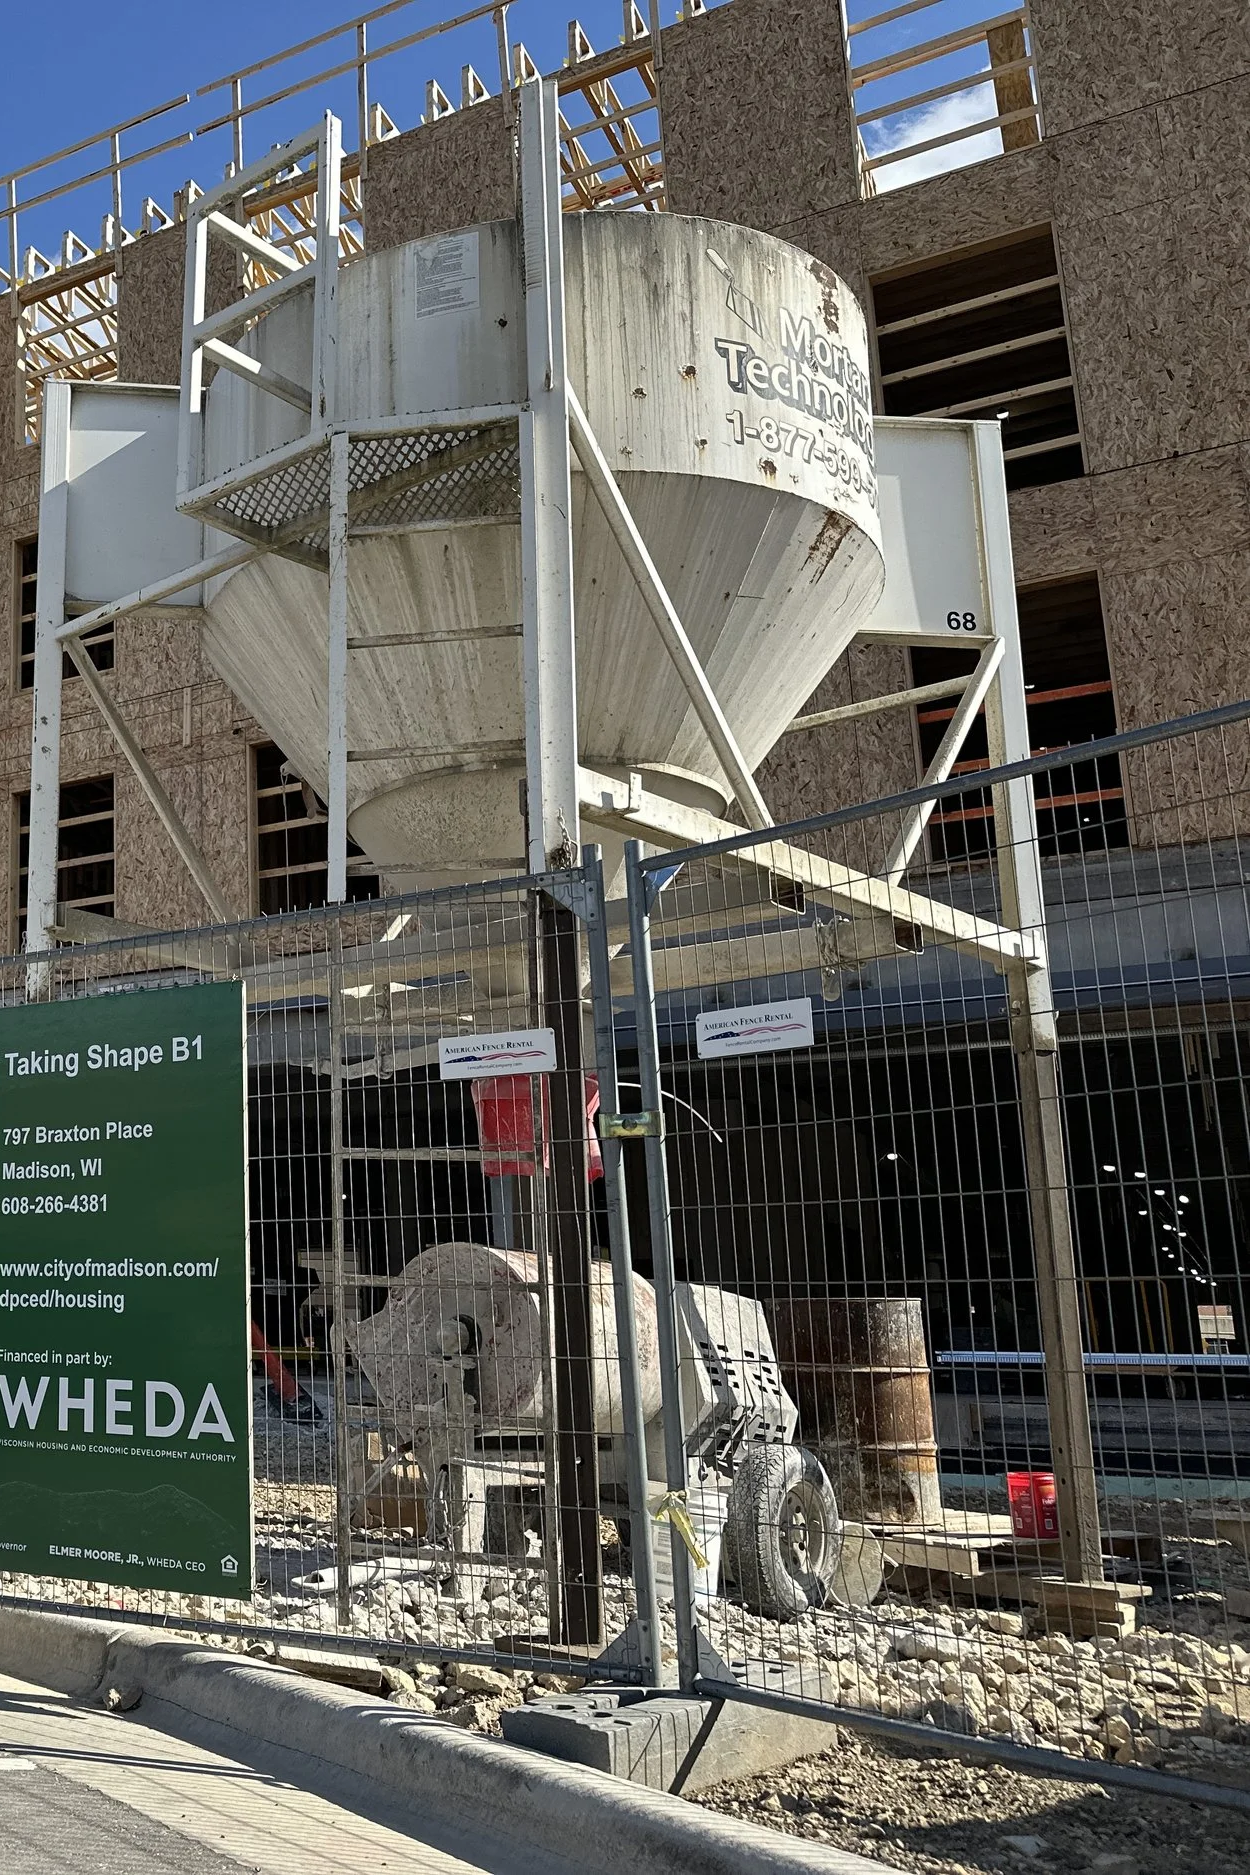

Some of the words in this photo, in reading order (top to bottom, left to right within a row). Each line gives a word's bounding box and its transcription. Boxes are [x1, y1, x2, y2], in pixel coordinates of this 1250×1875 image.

[778, 306, 871, 414] Mortar
[947, 611, 977, 632] 68
[703, 1021, 739, 1031] AMERICAN
[739, 1017, 763, 1026] FENCE
[764, 1012, 794, 1022] RENTAL
[4, 1049, 79, 1078] Taking
[86, 1043, 164, 1072] Shape
[172, 1034, 202, 1062] B1
[444, 1045, 481, 1055] AMERICAN
[481, 1043, 506, 1052] FENCE
[506, 1040, 534, 1049] RENTAL
[2, 1127, 31, 1146] 797
[35, 1124, 100, 1144] Braxton
[106, 1121, 153, 1140] Place
[2, 1160, 75, 1181] Madison,
[79, 1158, 102, 1177] WI
[1, 1193, 107, 1215] 608-266-4381
[0, 1257, 220, 1282] www.cityofmadison.com/
[0, 1288, 125, 1314] dpced/housing
[52, 1350, 62, 1364] in
[65, 1351, 91, 1367] part
[94, 1351, 113, 1368] by:
[36, 1441, 69, 1451] HOUSING
[70, 1444, 87, 1452] AND
[88, 1444, 129, 1455] ECONOMIC
[130, 1447, 188, 1459] DEVELOPMENT
[189, 1452, 237, 1463] AUTHORITY
[49, 1544, 82, 1558] ELMER
[83, 1548, 124, 1565] MOORE,
[125, 1553, 144, 1567] JR.,
[146, 1556, 183, 1570] WHEDA
[184, 1560, 206, 1572] CEO
